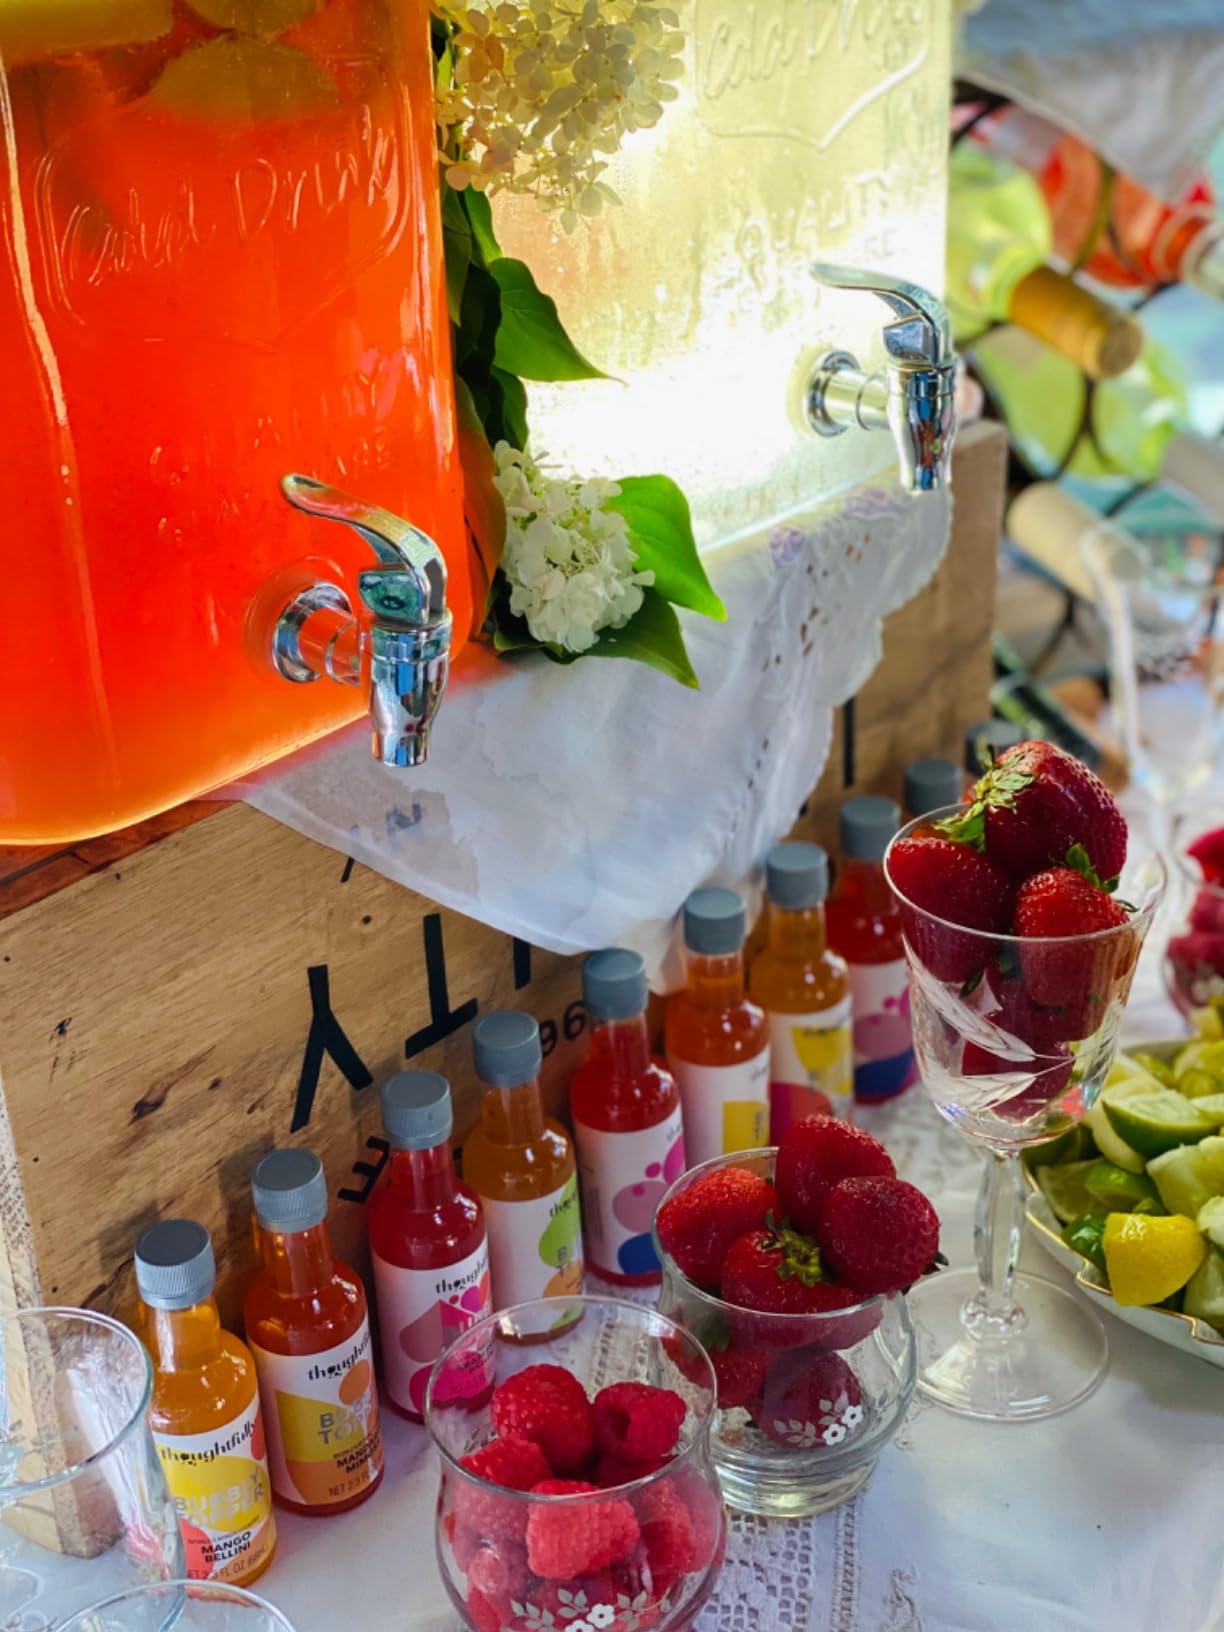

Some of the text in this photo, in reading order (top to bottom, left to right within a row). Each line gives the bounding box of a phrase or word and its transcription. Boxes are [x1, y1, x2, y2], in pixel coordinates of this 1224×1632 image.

[185, 1481, 264, 1530] OPPER
[201, 1531, 251, 1554] MANGO
[205, 1541, 250, 1563] BELLINI
